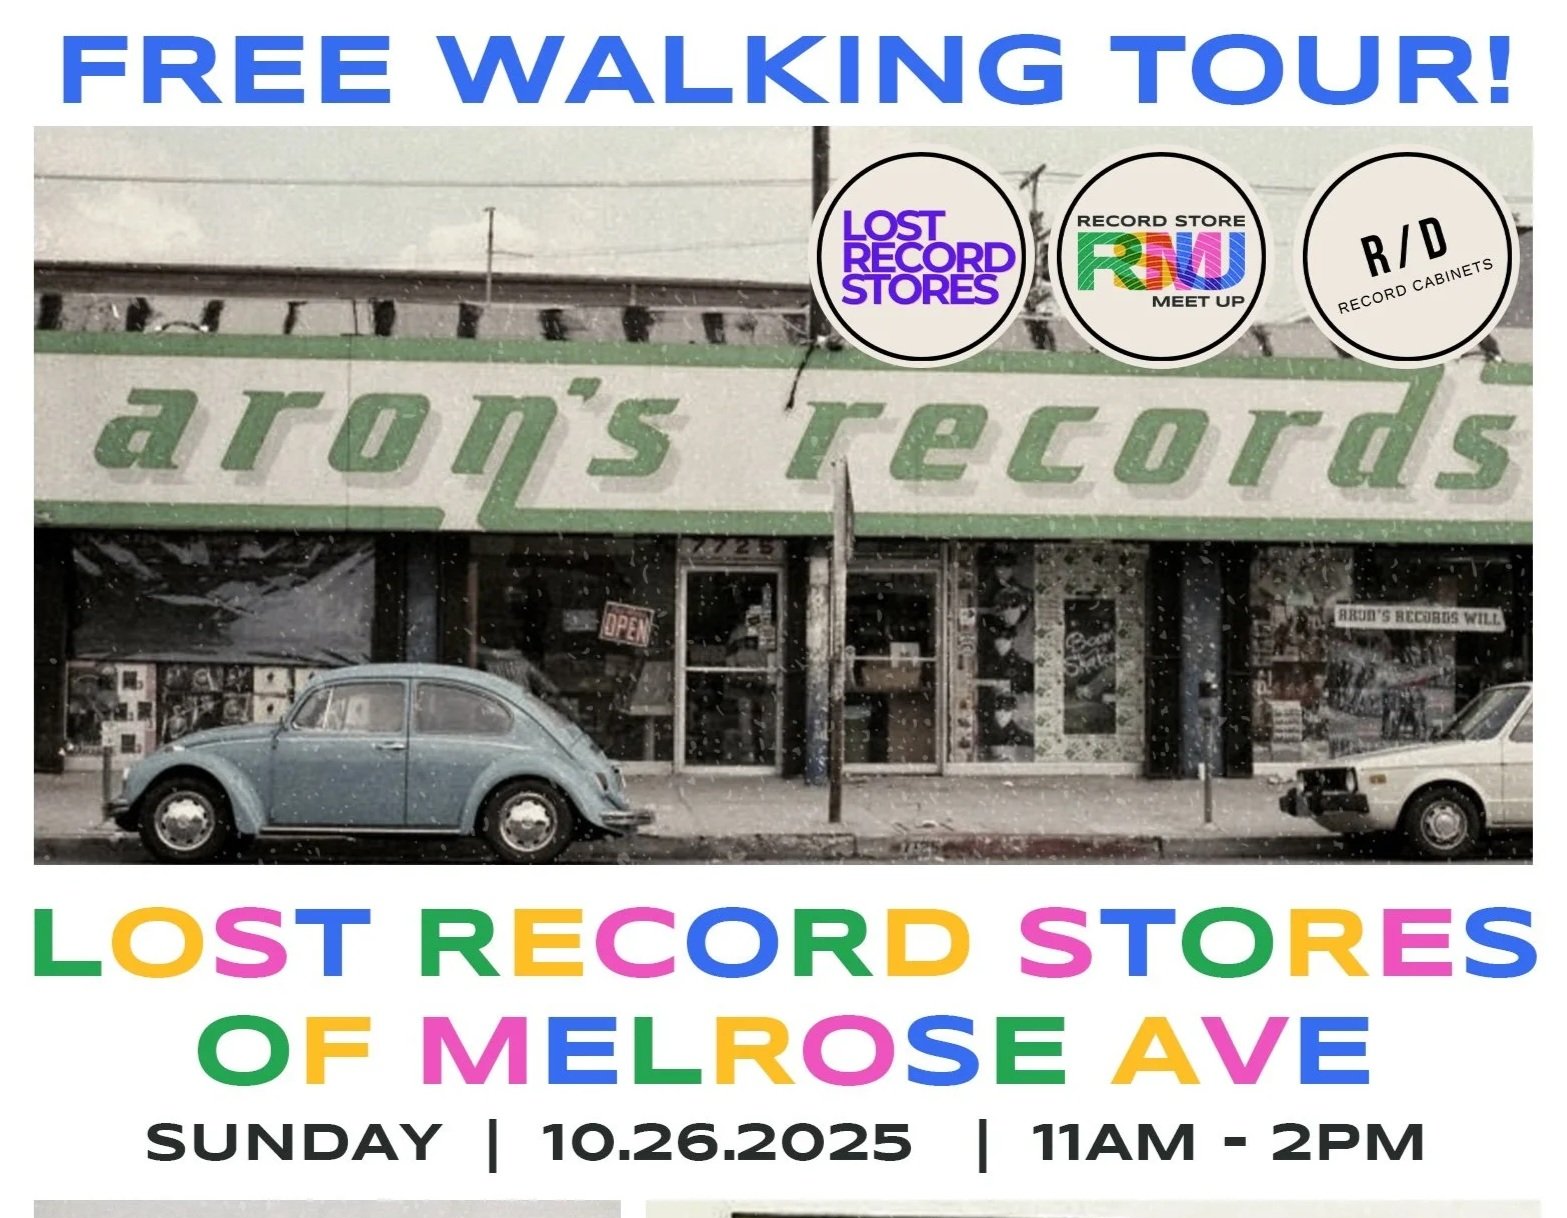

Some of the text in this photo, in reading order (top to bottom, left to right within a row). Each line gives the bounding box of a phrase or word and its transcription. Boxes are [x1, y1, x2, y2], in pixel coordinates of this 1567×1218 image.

[64, 33, 1510, 106] FREE WALKING TOUR!
[843, 209, 946, 241] LOST
[1077, 215, 1246, 227] RECORD STORE
[843, 241, 1016, 273] RECORD
[842, 273, 999, 305] STORES
[1152, 296, 1246, 308] MEET UP
[1338, 258, 1494, 314] RECORD CABINETS
[94, 370, 1517, 527] aron's records
[692, 538, 775, 555] 7725
[605, 613, 649, 642] OPEN
[1395, 610, 1459, 625] RECORDS
[1464, 611, 1501, 626] WILL
[34, 906, 1537, 979] LOST RECORD STORES
[198, 1014, 1370, 1087] OF MELROSE AVE
[147, 1122, 443, 1162] SUNDAY
[543, 1122, 912, 1162] 10.26.2025
[1033, 1123, 1194, 1161] 11AM
[1272, 1122, 1423, 1161] 2PM
